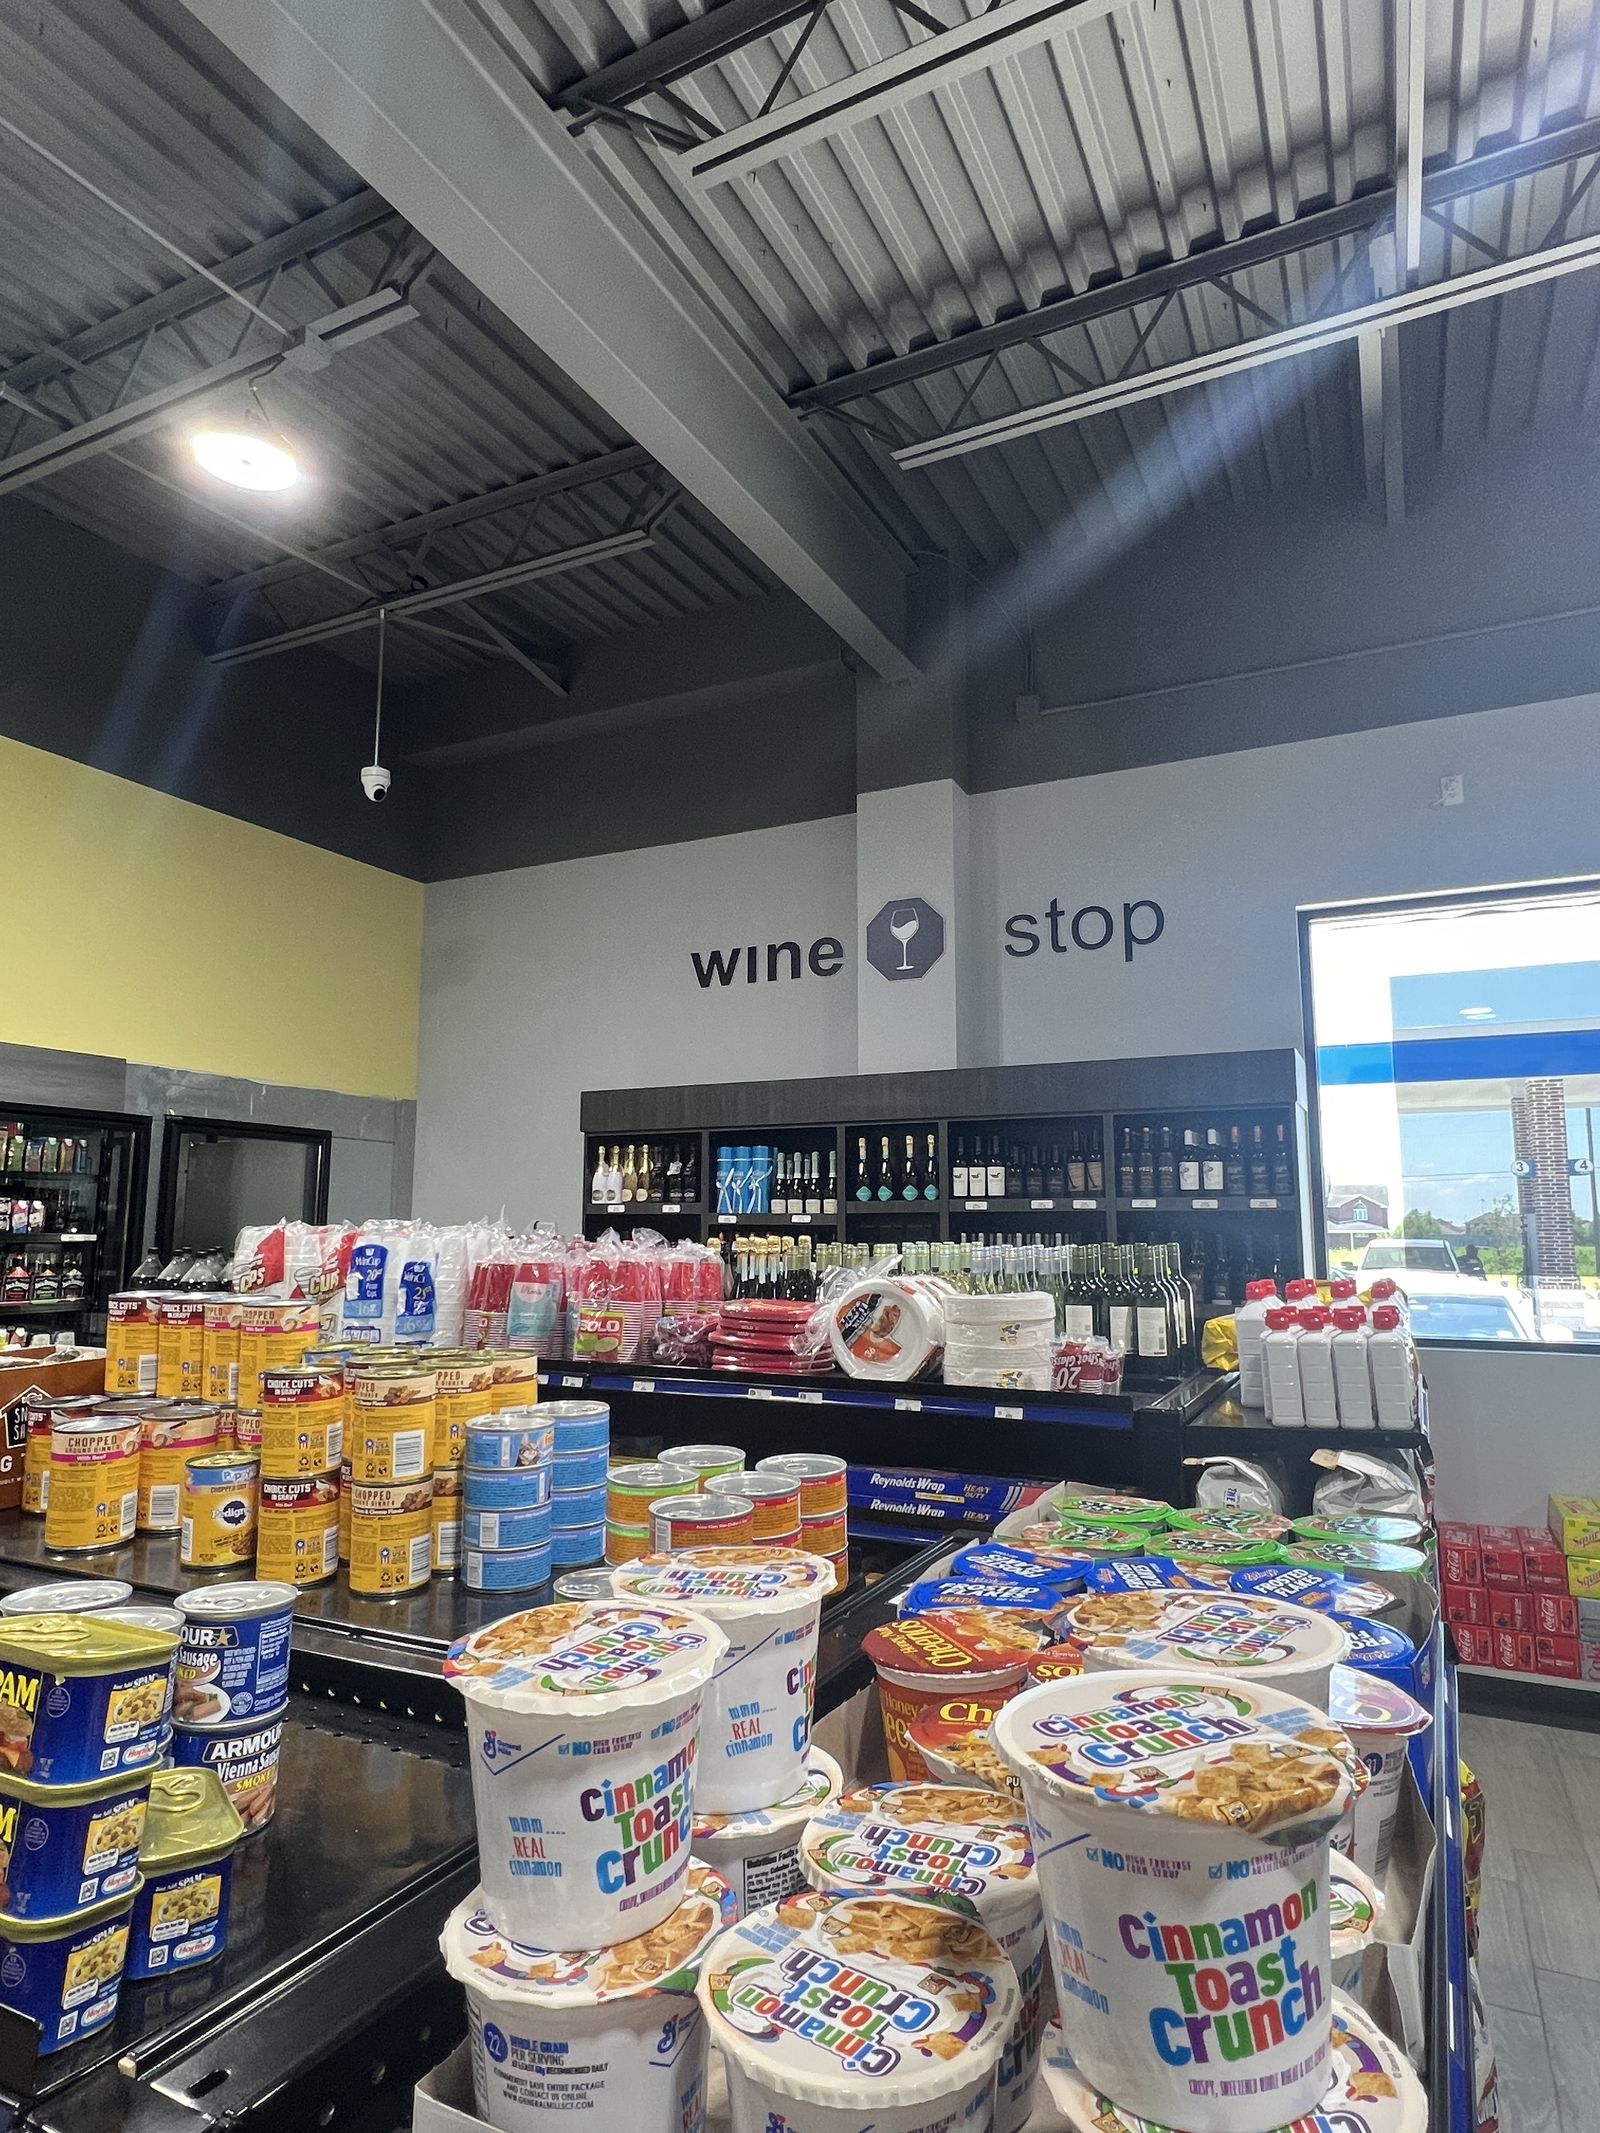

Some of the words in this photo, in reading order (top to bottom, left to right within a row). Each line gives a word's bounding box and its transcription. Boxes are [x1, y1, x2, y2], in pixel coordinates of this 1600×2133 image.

[690, 936, 844, 989] wine
[1003, 897, 1165, 962] stop
[1516, 1162, 1524, 1172] 3
[1579, 1160, 1588, 1170] 4
[355, 1256, 382, 1267] WinCup
[580, 1318, 620, 1333] SOLO
[267, 1379, 290, 1389] CHOICE
[292, 1378, 315, 1388] CUTS
[1056, 1366, 1081, 1390] 20
[68, 1436, 118, 1448] CHOPPED
[263, 1483, 287, 1493] CHOICE
[288, 1483, 311, 1493] CUTS
[870, 1472, 917, 1490] Reynolds
[917, 1477, 945, 1493] Wrap
[963, 1483, 992, 1493] HEAVY
[963, 1510, 992, 1521] HEAVY
[668, 1570, 784, 1584] Crunch
[938, 1582, 1040, 1595] FROSTED
[1253, 1568, 1310, 1595] FROSTED
[1274, 1574, 1324, 1598] FLAKES
[648, 1584, 778, 1598] Cinnamon
[1160, 1605, 1253, 1645] Crunch
[1225, 1616, 1308, 1656] Cinnamon
[540, 1623, 658, 1671] Crunch
[581, 1636, 661, 1672] Toast
[892, 1620, 973, 1667] Cheerios
[179, 1649, 218, 1673] Sausage
[585, 1634, 703, 1687] Cinnamon
[1039, 1690, 1202, 1736] Cinnamon
[1085, 1708, 1199, 1742] Toast
[731, 1717, 762, 1741] REAL
[1082, 1716, 1250, 1765] Crunch
[572, 1740, 592, 1756] NO
[725, 1732, 773, 1758] cinnamon
[216, 1756, 258, 1782] Vienna
[614, 1767, 692, 1850] Toast
[513, 1836, 547, 1859] REAL
[864, 1824, 997, 1865] Crunch
[509, 1860, 562, 1878] cinnamon
[874, 1845, 967, 1876] Toast
[1101, 1848, 1125, 1872] NO
[1226, 1860, 1250, 1880] NO
[178, 1873, 203, 1889] SPAM
[836, 1853, 986, 1895] Cinnamon
[1118, 1878, 1319, 1962] Cinnamon
[178, 1938, 212, 1954] Hormel
[1164, 1934, 1303, 2015] Toast
[785, 1949, 933, 2031] Crunch
[783, 1979, 888, 2042] Toast
[1148, 1958, 1322, 2067] Crunch
[736, 1986, 898, 2075] Cinnamon
[527, 2050, 565, 2067] SERVING
[519, 2088, 550, 2101] CONTACT
[560, 2091, 587, 2101] ONLINE
[571, 2080, 605, 2092] PACKAGE
